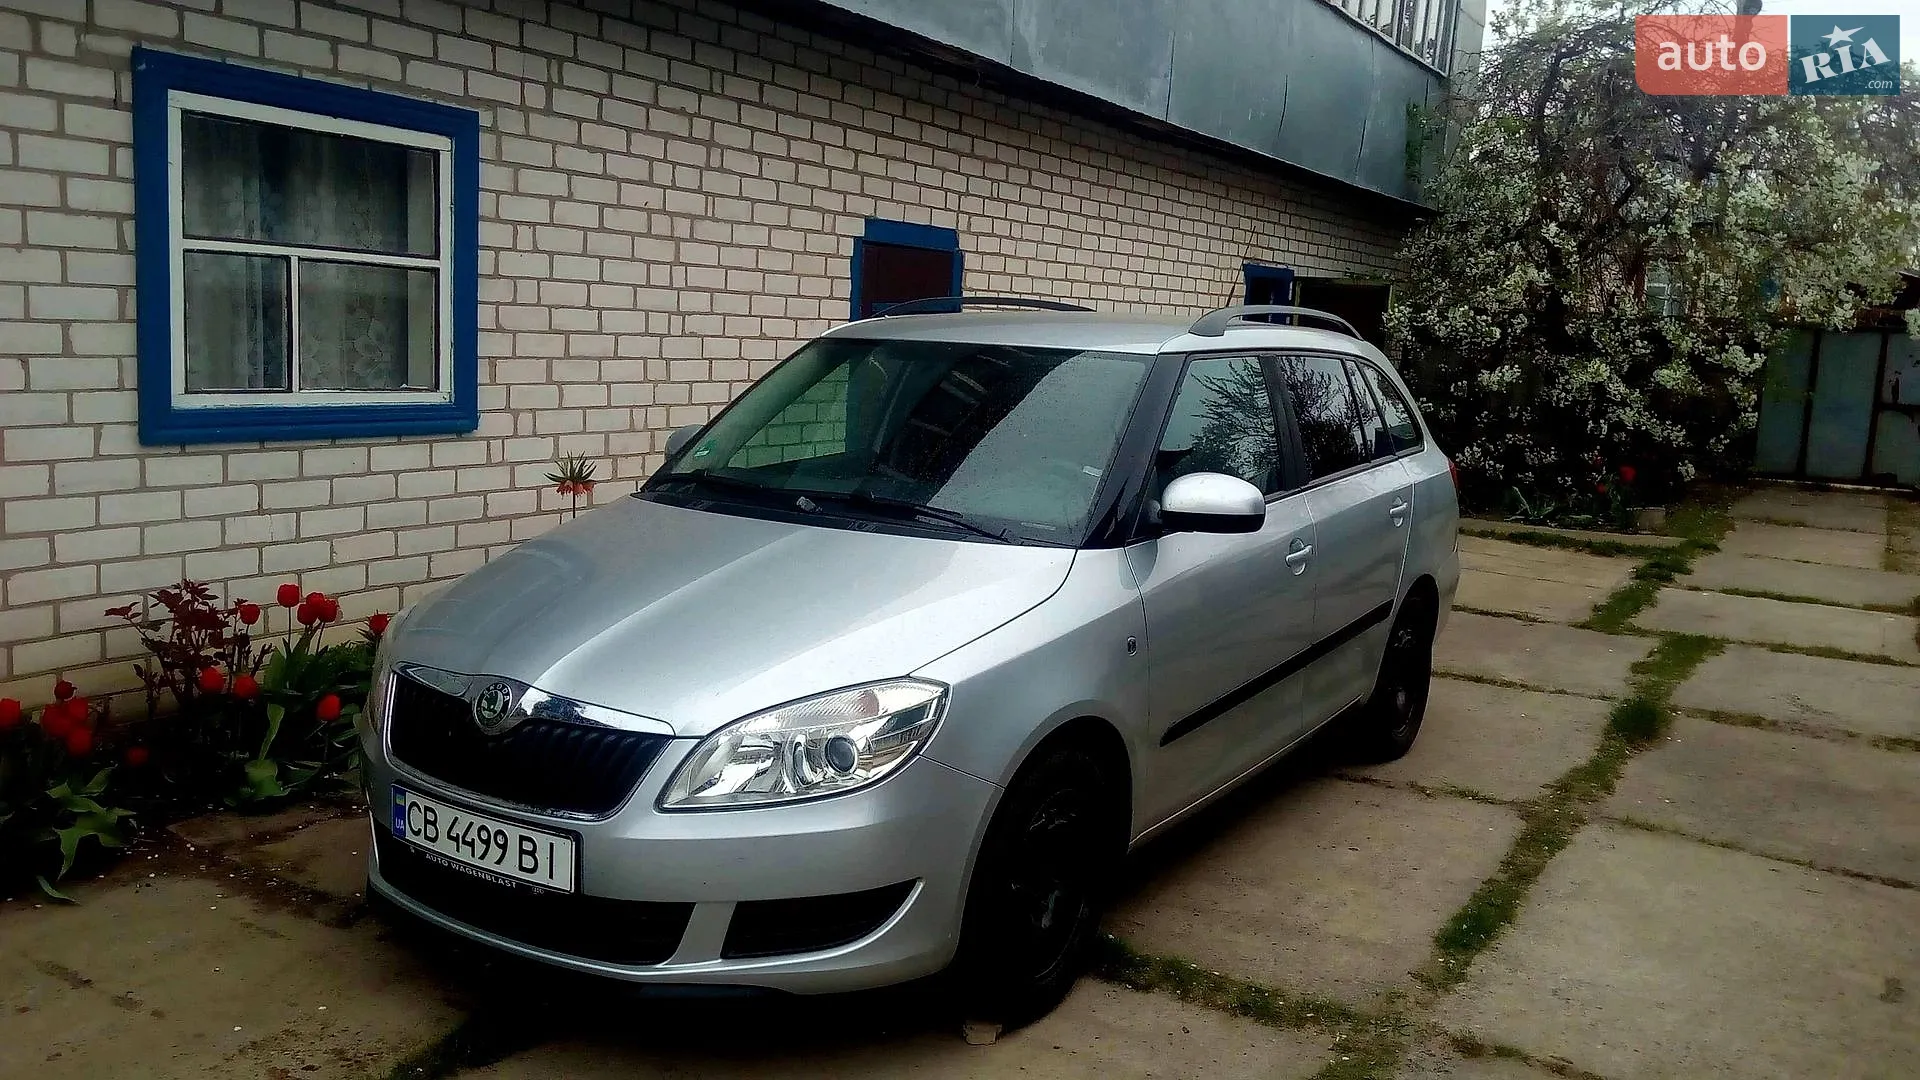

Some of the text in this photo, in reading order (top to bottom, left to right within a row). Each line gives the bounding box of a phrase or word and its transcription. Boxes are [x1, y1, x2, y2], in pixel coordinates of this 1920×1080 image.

[395, 816, 405, 831] UA
[407, 800, 554, 880] CB 4499 BI
[426, 853, 517, 888] AUTO WAGENBLAST
